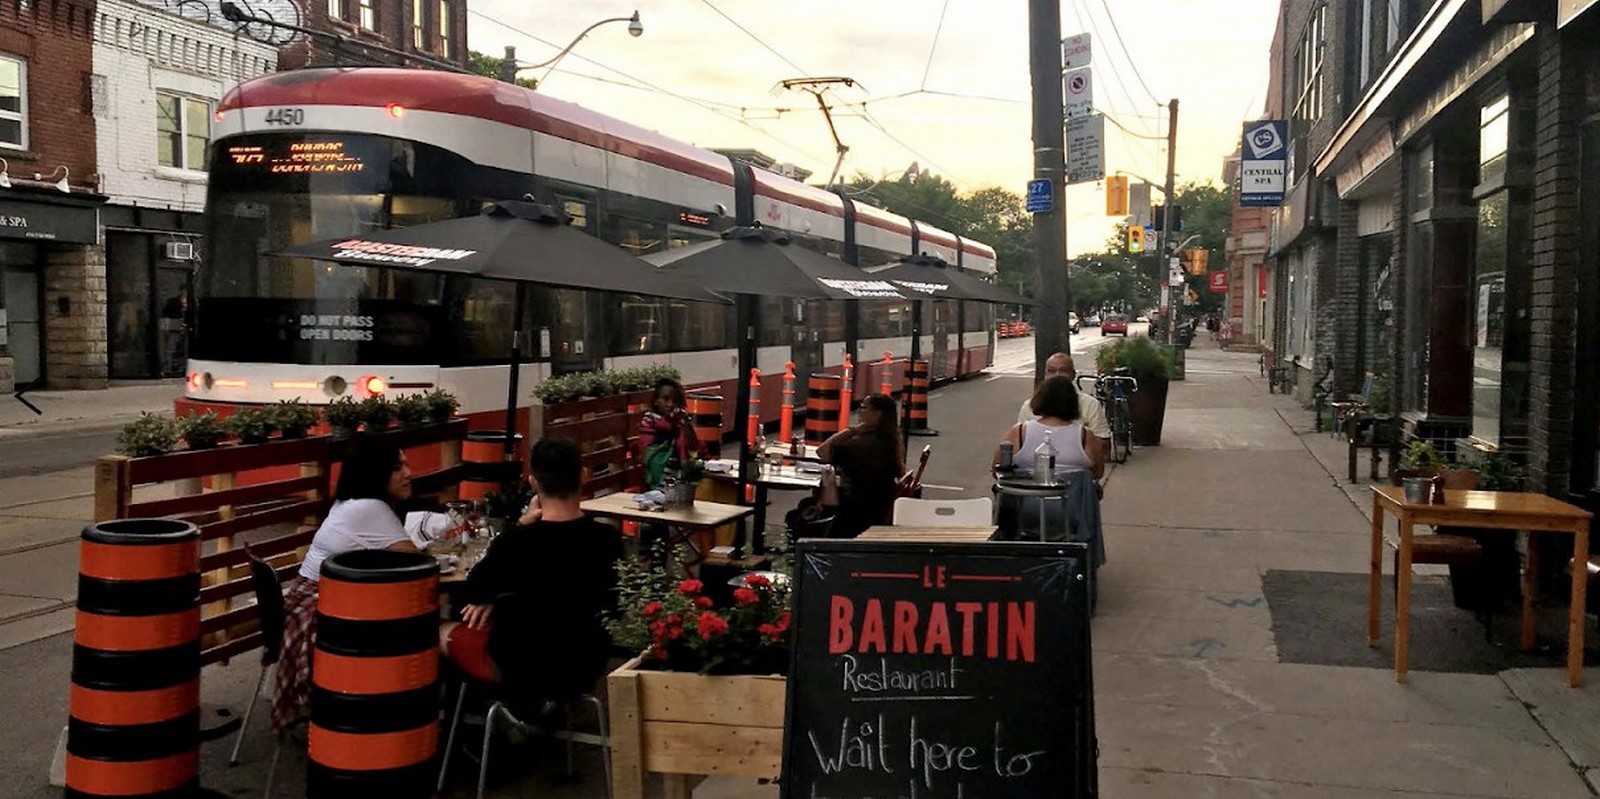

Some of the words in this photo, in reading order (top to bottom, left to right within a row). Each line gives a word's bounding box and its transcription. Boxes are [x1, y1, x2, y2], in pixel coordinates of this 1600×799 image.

[265, 108, 304, 126] 4450
[1254, 131, 1273, 146] CS
[1031, 182, 1044, 194] 27
[1254, 177, 1272, 185] SPA
[9, 216, 28, 227] SPA
[300, 314, 317, 326] DO
[318, 315, 341, 326] NOT
[342, 315, 374, 327] PASS
[300, 328, 330, 340] OPEN
[332, 329, 374, 341] DOORS
[923, 565, 947, 588] LE
[828, 595, 1035, 663] BARATIN
[842, 654, 964, 692] Restaurant
[808, 714, 894, 775] Wait
[909, 716, 982, 789] here
[994, 721, 1048, 777] to
